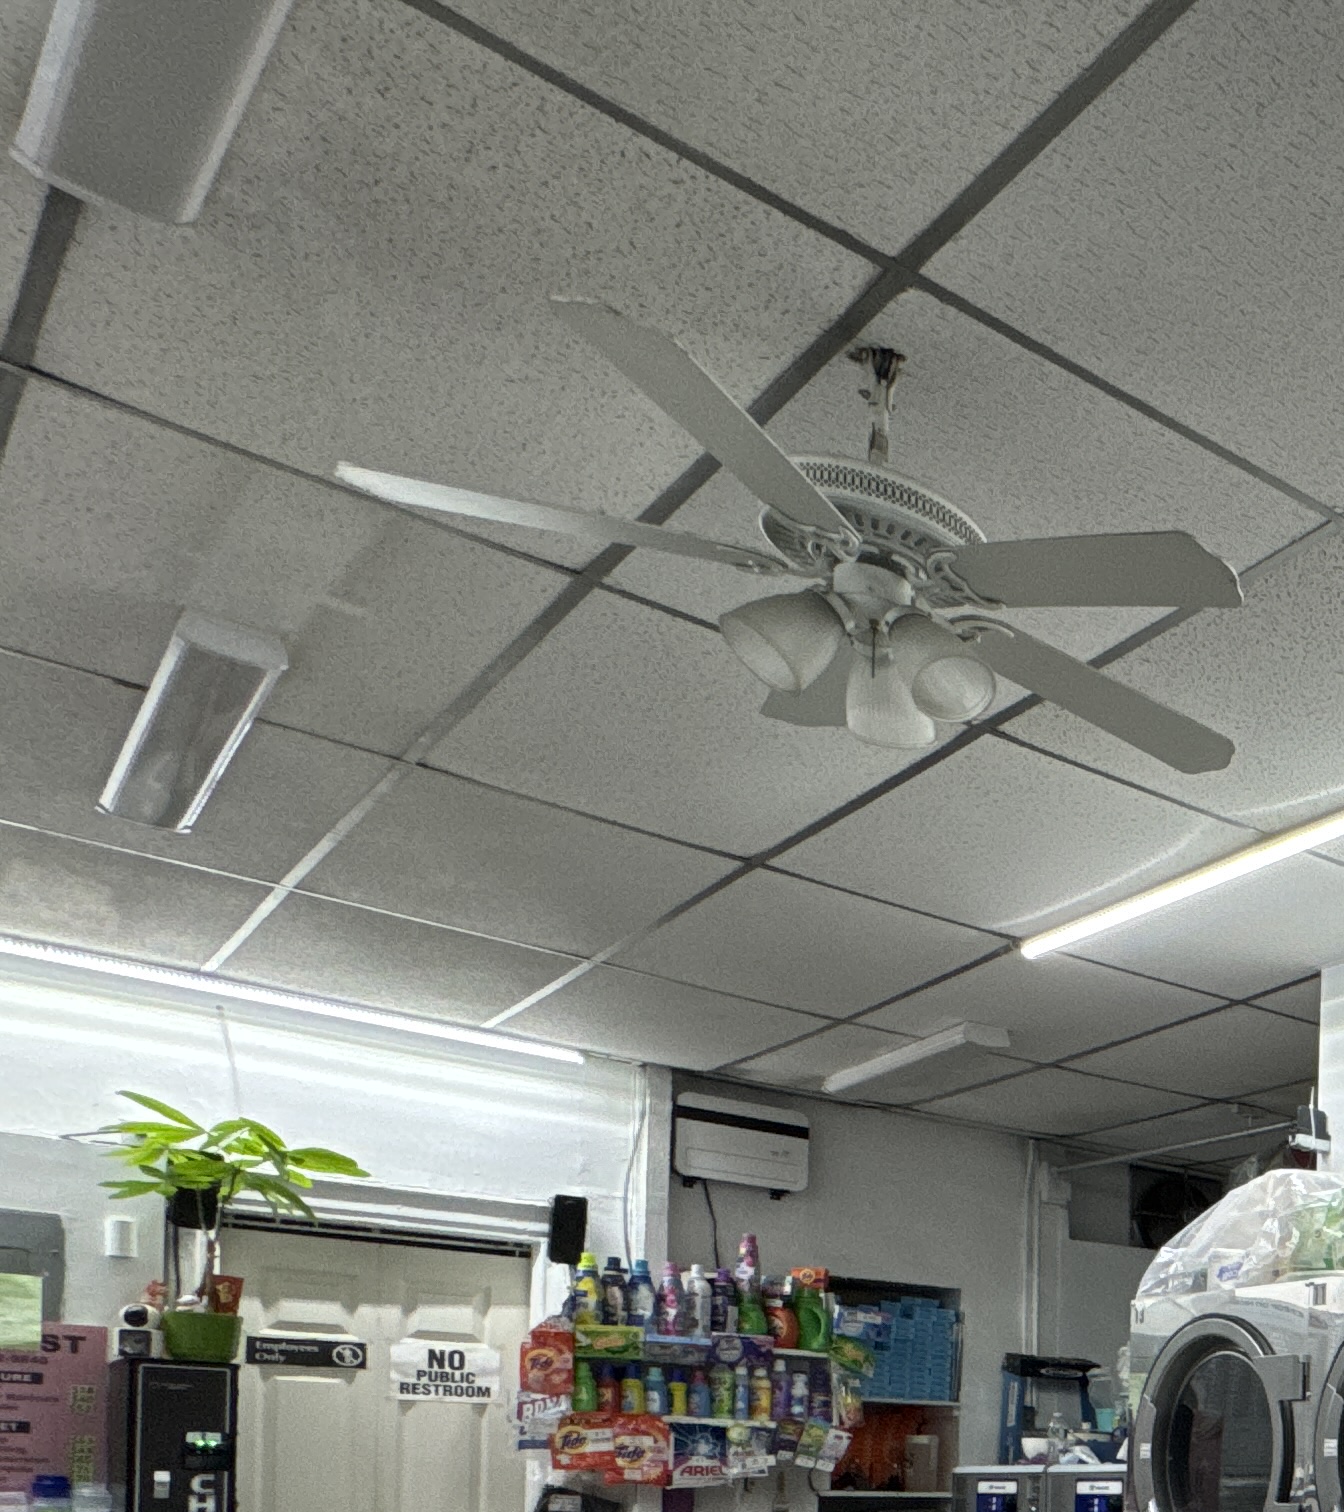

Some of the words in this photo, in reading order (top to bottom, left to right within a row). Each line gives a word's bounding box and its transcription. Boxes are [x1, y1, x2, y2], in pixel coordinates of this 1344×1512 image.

[255, 1341, 319, 1353] Employees
[255, 1352, 287, 1364] Only
[428, 1349, 465, 1371] NO
[416, 1370, 476, 1384] PUBLIC
[400, 1382, 491, 1399] RESTROOM
[559, 1434, 587, 1450] Tide
[615, 1445, 646, 1461] Tide
[680, 1465, 727, 1477] ARIEL
